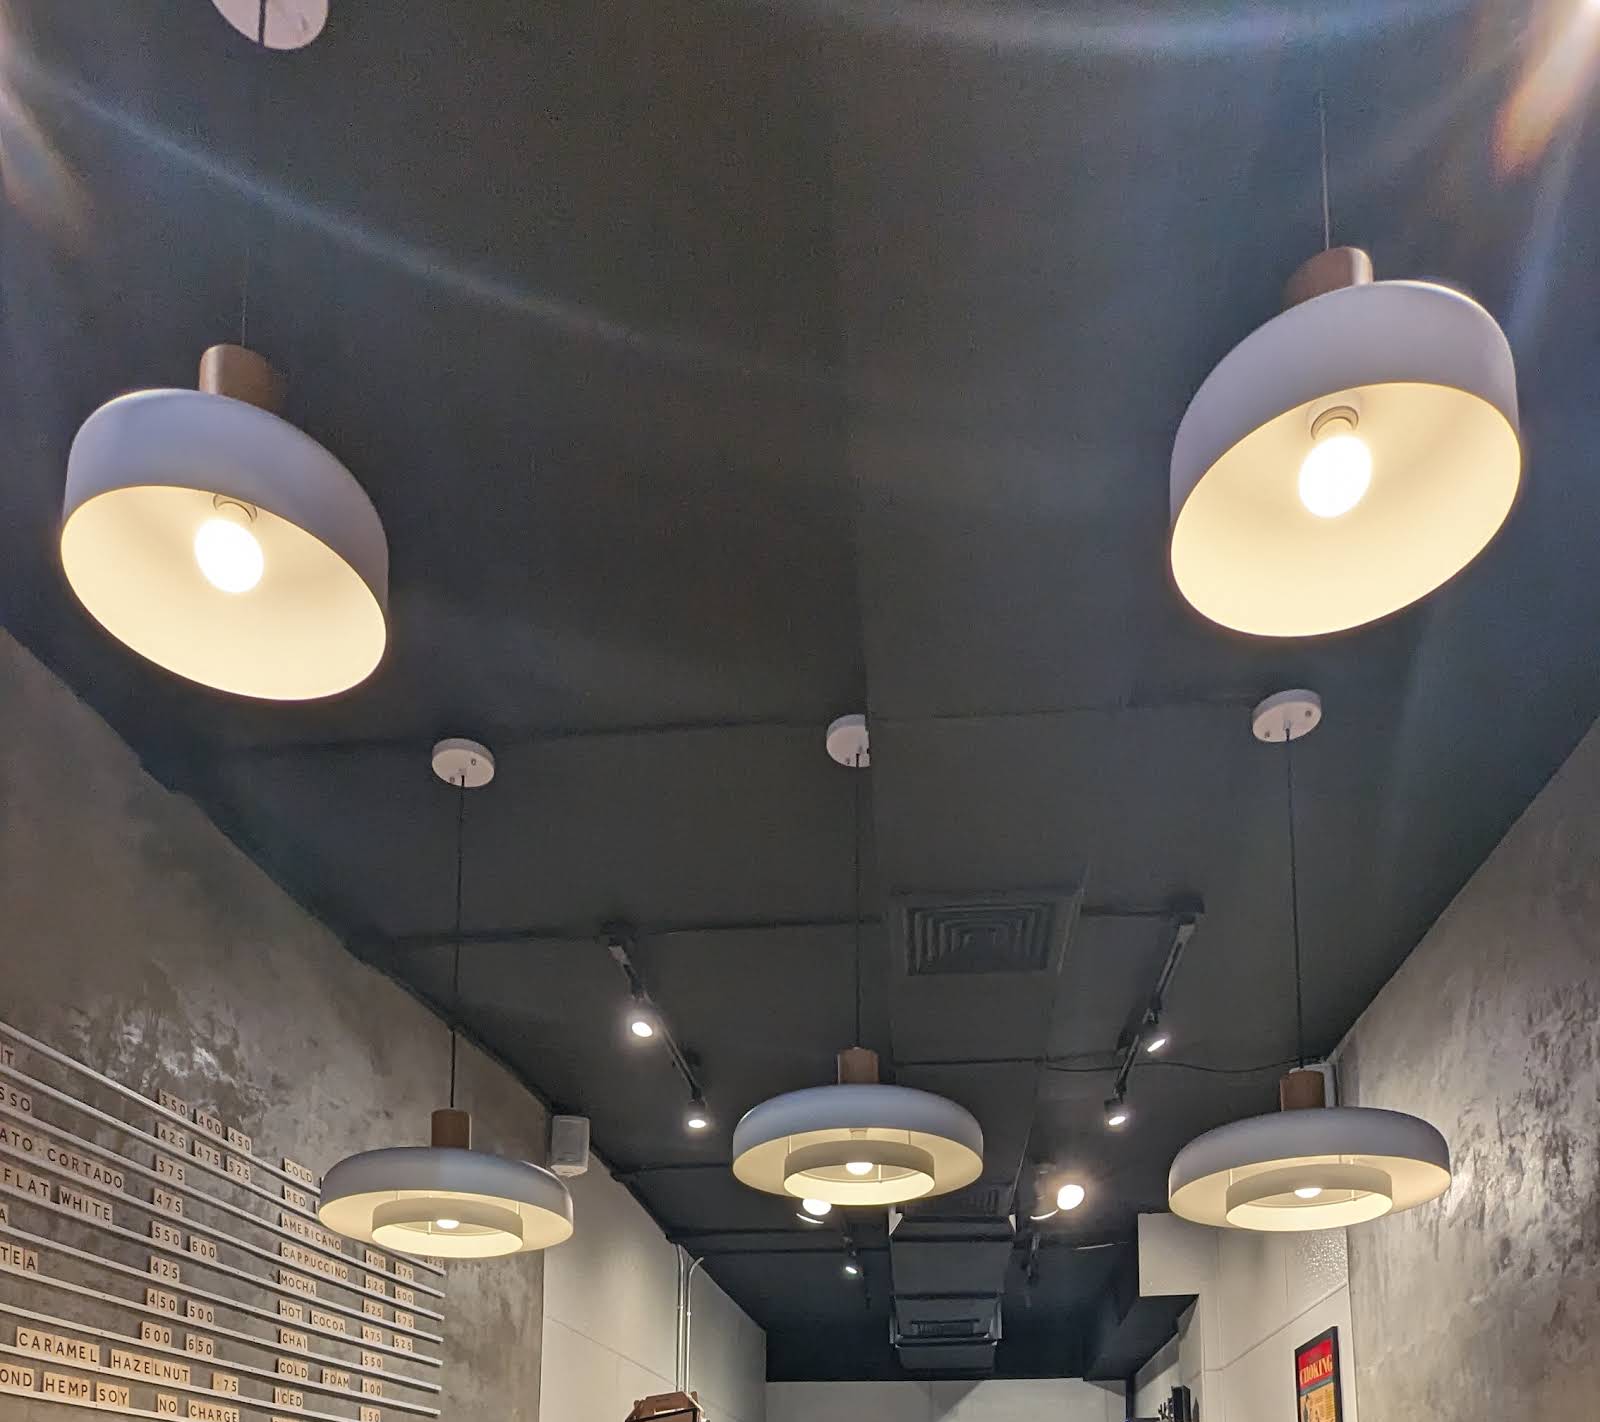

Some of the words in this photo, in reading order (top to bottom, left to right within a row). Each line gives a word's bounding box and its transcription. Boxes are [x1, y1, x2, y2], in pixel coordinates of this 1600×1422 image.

[162, 1094, 186, 1116] 350
[198, 1115, 221, 1135] 400
[229, 1132, 250, 1150] 450
[47, 1148, 123, 1189] CORTADO
[159, 1161, 184, 1180] 375
[160, 1129, 185, 1148] 425
[197, 1146, 219, 1165] 475
[229, 1160, 250, 1180] 525
[286, 1162, 313, 1184] COLD
[4, 1168, 49, 1197] FLAT
[61, 1190, 111, 1222] WHITE
[156, 1194, 181, 1213] 475
[286, 1189, 306, 1207] RED
[154, 1227, 179, 1246] 550
[192, 1241, 215, 1258] 600
[283, 1216, 341, 1249] AMERICANO
[152, 1260, 178, 1279] 425
[281, 1274, 315, 1295] MOCHA
[283, 1245, 348, 1280] CAPPUCCINO
[367, 1281, 384, 1294] 525
[149, 1293, 176, 1312] 450
[190, 1306, 213, 1323] 500
[144, 1327, 170, 1344] 600
[188, 1338, 212, 1355] 650
[282, 1304, 301, 1319] HOT
[313, 1314, 345, 1332] COCOA
[364, 1331, 381, 1343] 475
[395, 1338, 412, 1350] 525
[18, 1332, 97, 1363] CARAMEL
[113, 1354, 189, 1384] HAZELNUT
[282, 1333, 307, 1348] CHAI
[364, 1355, 382, 1368] 550
[45, 1377, 88, 1396] HEMP
[99, 1389, 128, 1405] SOY
[160, 1398, 177, 1413] NO
[280, 1362, 308, 1378] COLD
[324, 1372, 349, 1387] FOAM
[364, 1381, 381, 1396] 100
[277, 1391, 303, 1407] ICED
